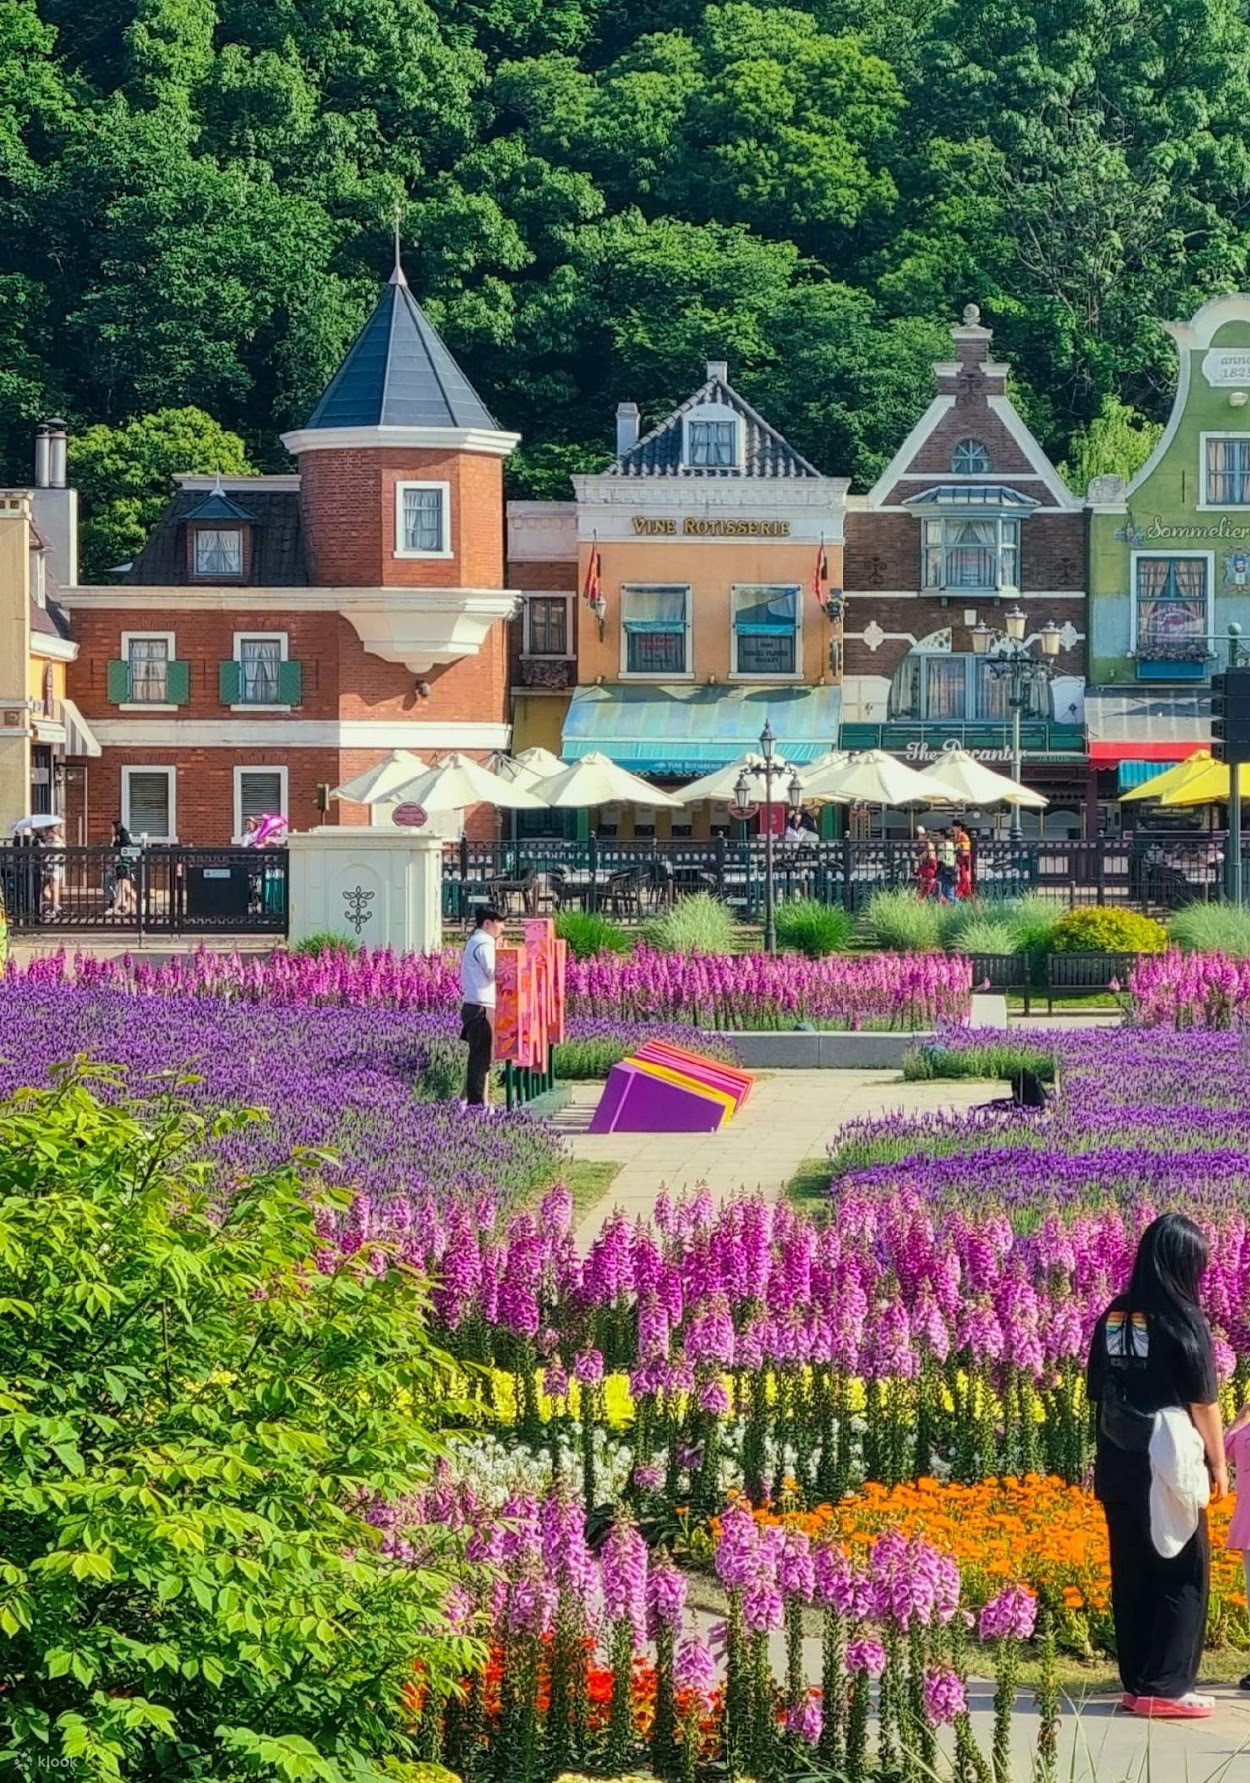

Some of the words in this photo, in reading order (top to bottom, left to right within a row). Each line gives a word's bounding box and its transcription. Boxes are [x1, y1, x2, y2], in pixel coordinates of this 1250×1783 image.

[632, 515, 677, 534] VINE
[683, 517, 791, 536] ROTISSERIE
[1147, 515, 1250, 539] Sommelier
[905, 742, 938, 761] The
